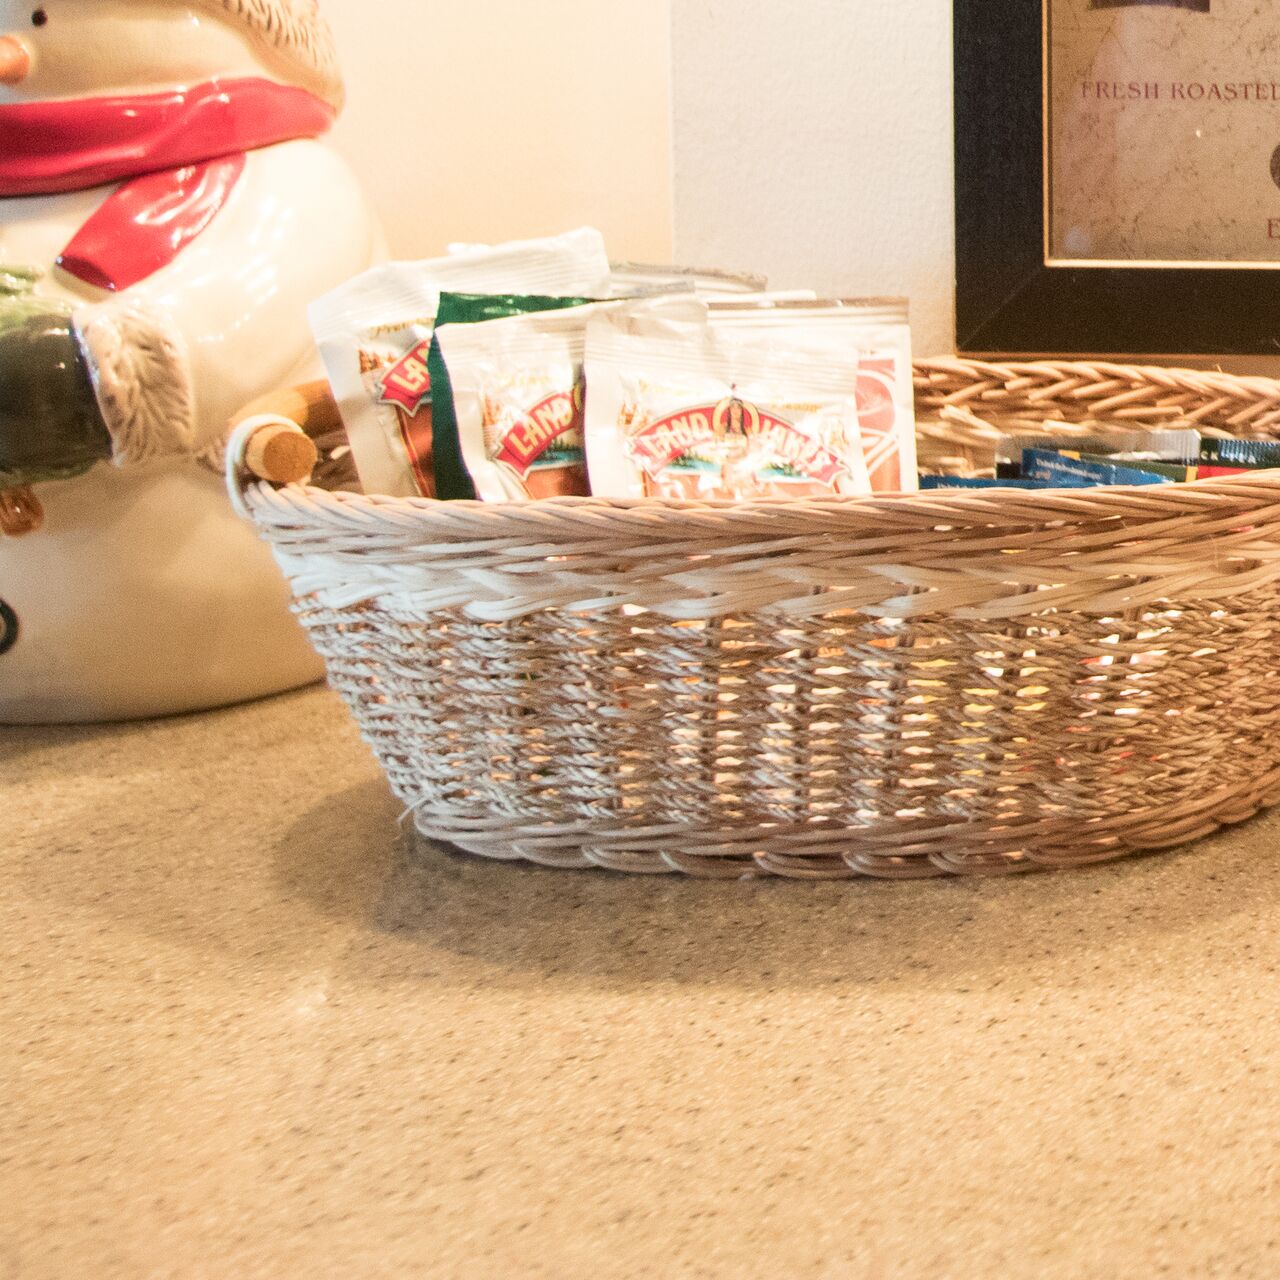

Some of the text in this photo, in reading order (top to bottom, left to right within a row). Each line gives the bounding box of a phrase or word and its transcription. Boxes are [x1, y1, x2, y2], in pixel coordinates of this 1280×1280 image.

[1081, 81, 1159, 101] FRESH
[509, 395, 574, 458] LAND
[644, 411, 714, 461] LAND
